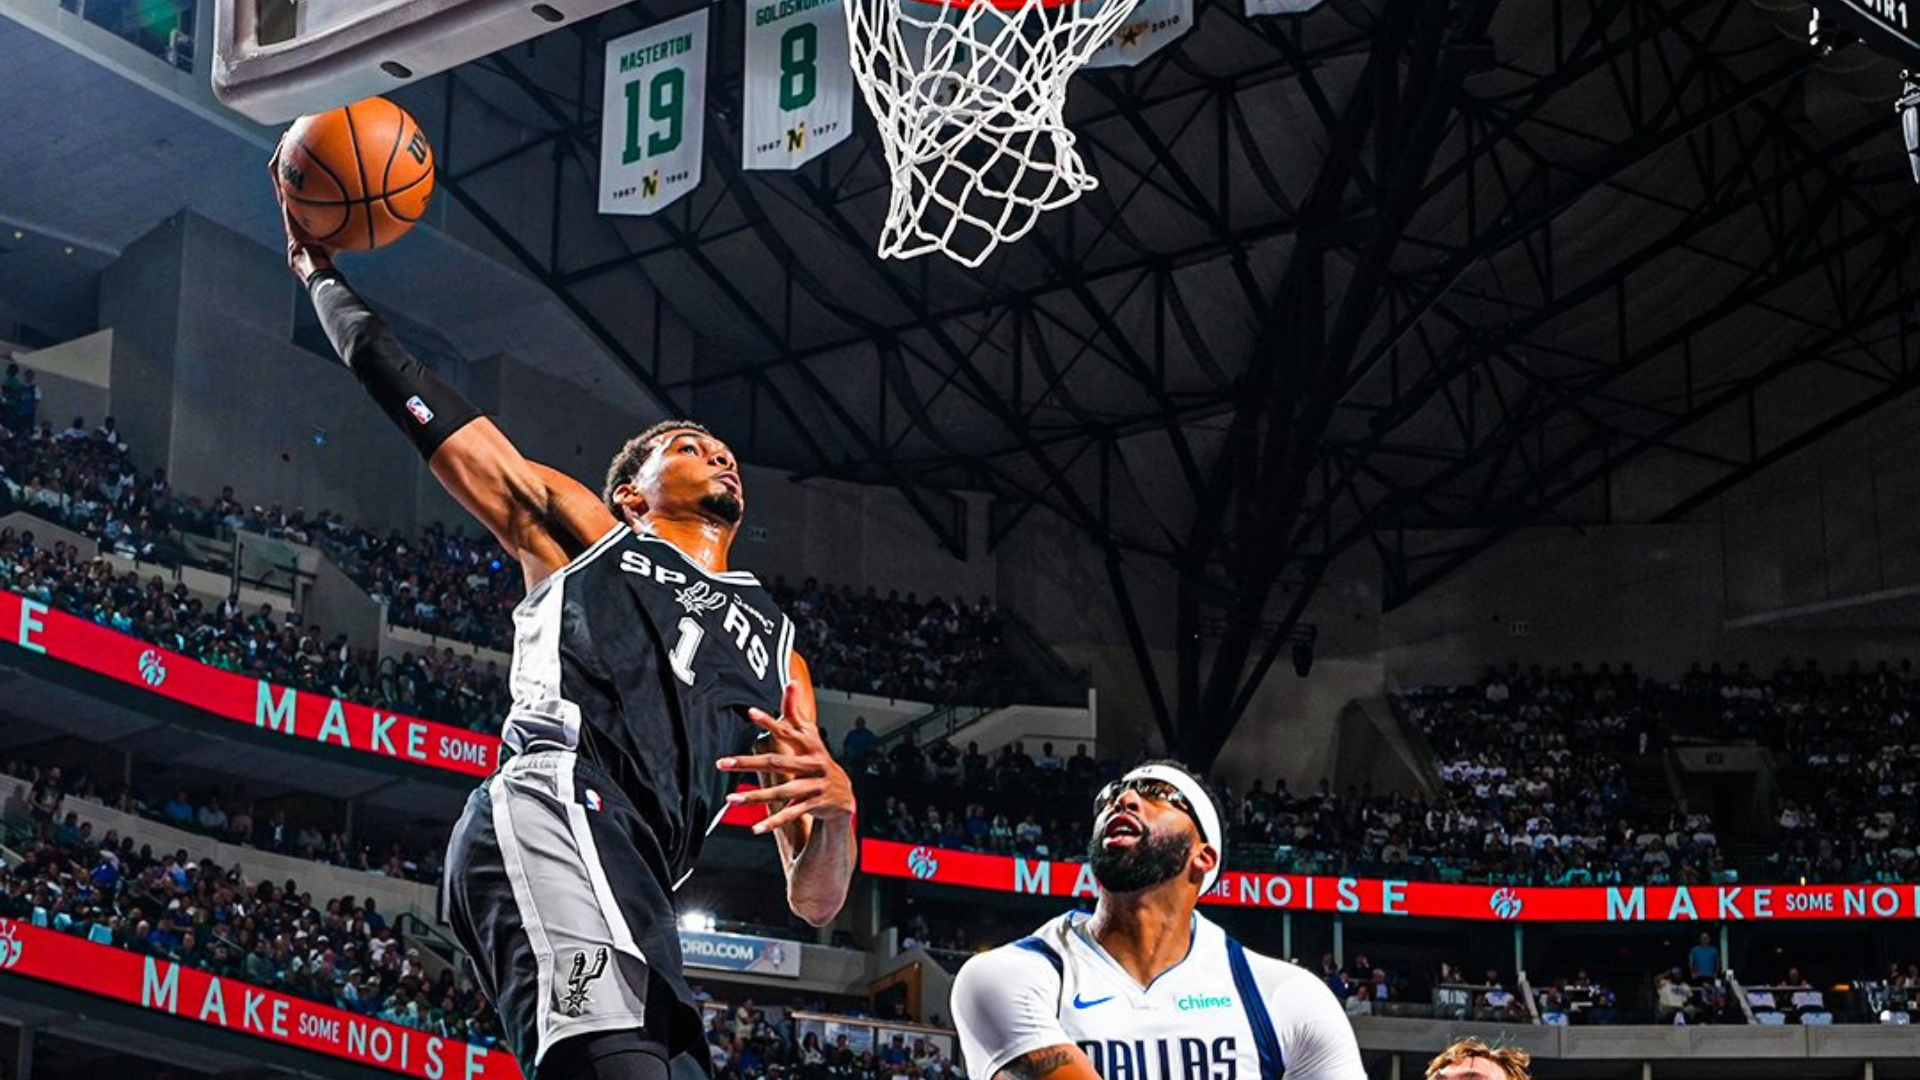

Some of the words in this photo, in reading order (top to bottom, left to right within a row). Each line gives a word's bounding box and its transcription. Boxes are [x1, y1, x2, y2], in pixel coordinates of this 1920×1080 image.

[756, 0, 837, 26] GOLDSWO
[620, 33, 693, 73] MASTERTON
[779, 22, 817, 112] 8
[622, 67, 686, 166] 19
[668, 617, 704, 686] 1
[255, 680, 428, 760] MAKE
[439, 736, 488, 767] SOME
[1014, 857, 1100, 898] MA
[1240, 876, 1409, 915] NOISE
[1606, 886, 1773, 921] MAKE
[1786, 893, 1833, 911] SOME
[141, 955, 290, 1037] MAKE
[298, 1012, 341, 1043] SOME
[1178, 993, 1232, 1011] chime
